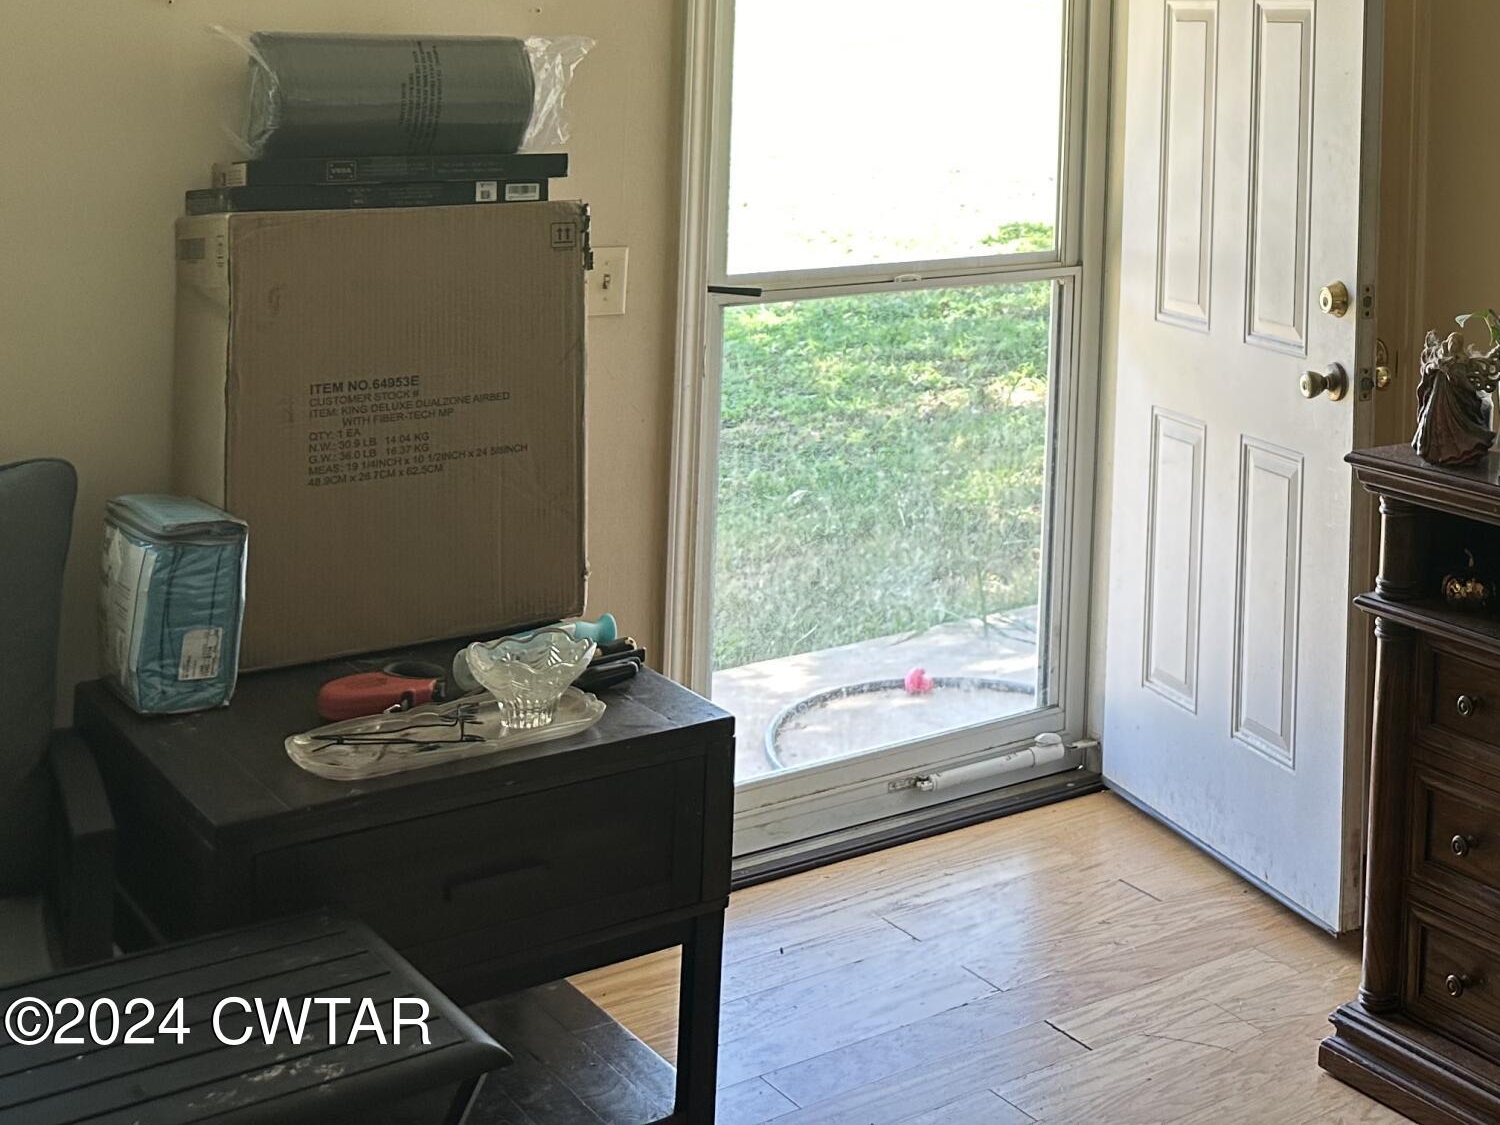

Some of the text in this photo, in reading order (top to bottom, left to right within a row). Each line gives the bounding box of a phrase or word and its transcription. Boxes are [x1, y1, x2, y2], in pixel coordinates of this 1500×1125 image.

[310, 375, 420, 395] ITEM NO.64953E
[309, 393, 372, 407] CUSTOMER
[374, 389, 410, 401] STOCK
[341, 404, 368, 415] KING
[371, 401, 413, 413] DELUXE
[416, 396, 471, 409] DUALZONE
[473, 392, 510, 404] AIRBED
[342, 416, 370, 426] WITH
[373, 409, 435, 425] FIBER-TECH
[346, 428, 361, 438] EA
[414, 432, 430, 442] KG
[363, 437, 377, 447] LB
[414, 443, 430, 452] KG
[363, 449, 377, 458] LB
